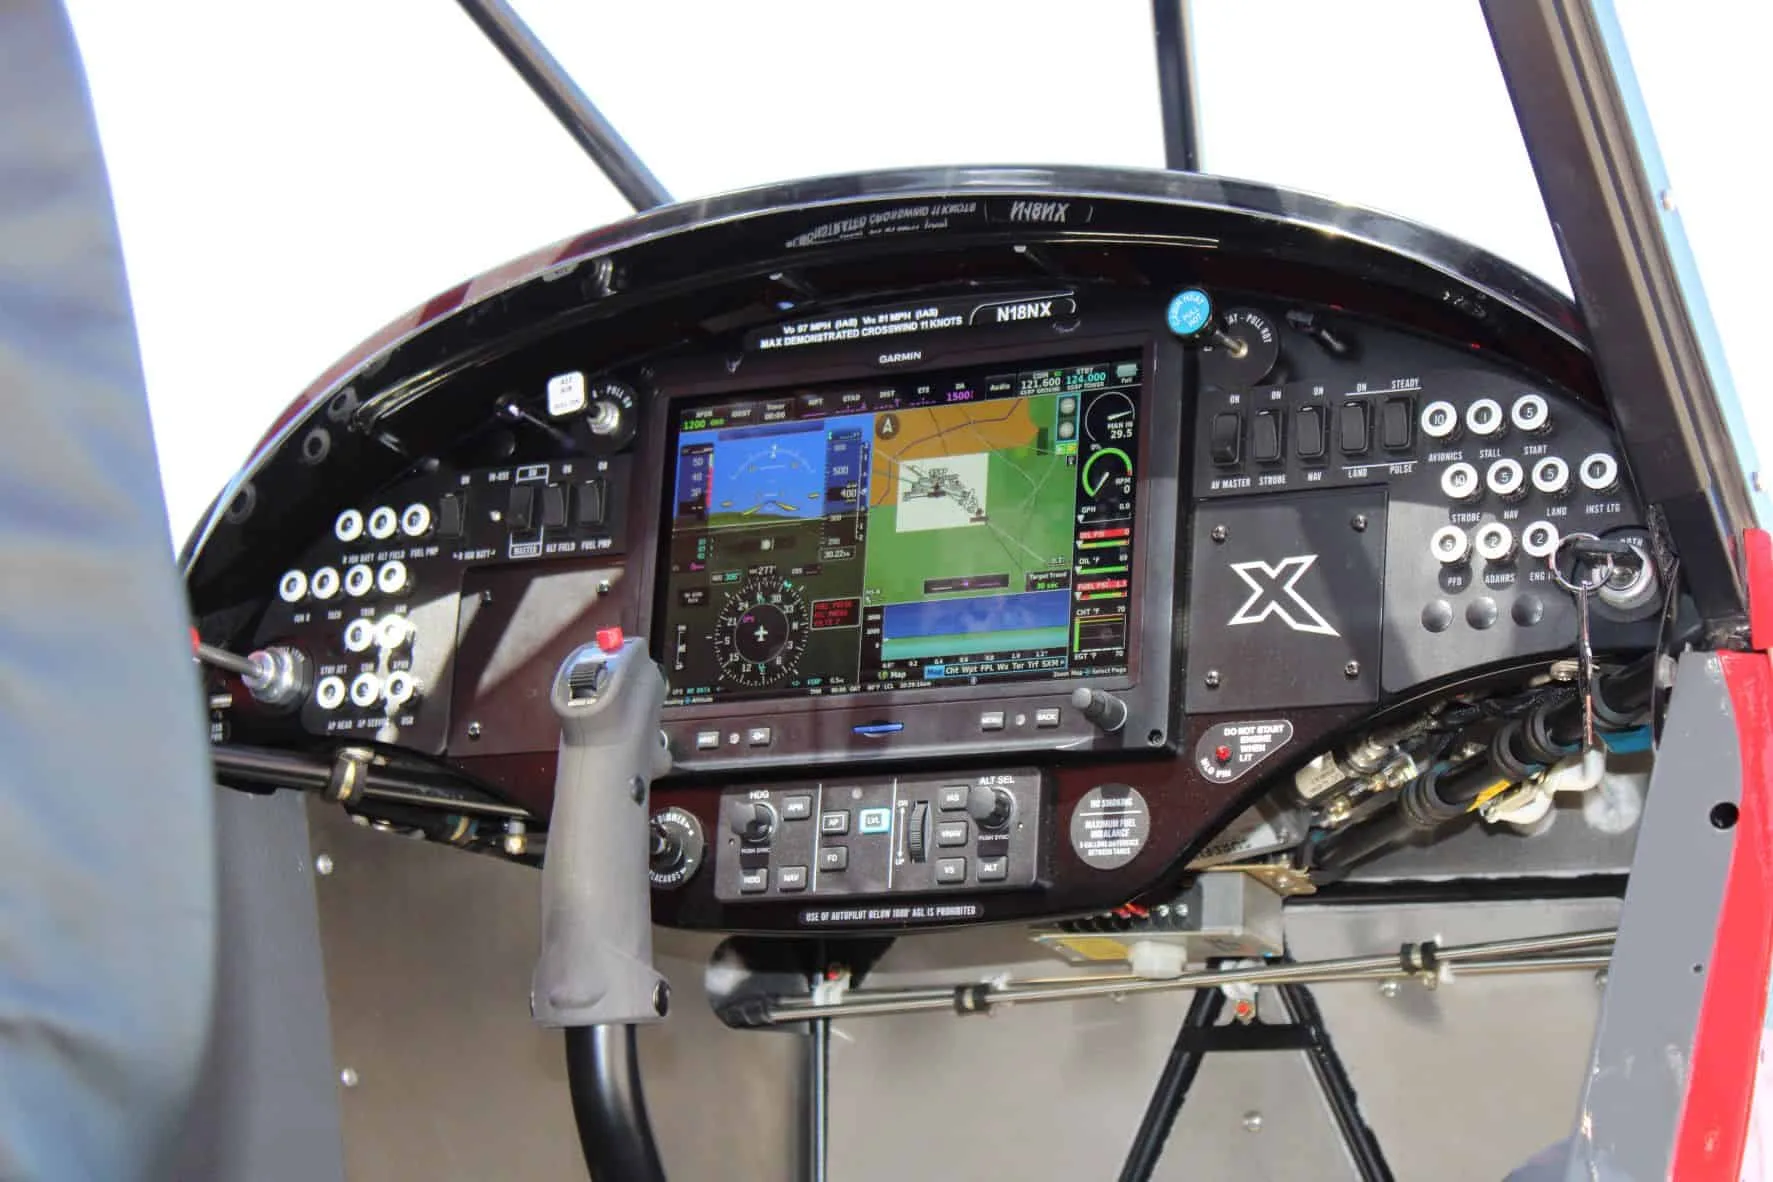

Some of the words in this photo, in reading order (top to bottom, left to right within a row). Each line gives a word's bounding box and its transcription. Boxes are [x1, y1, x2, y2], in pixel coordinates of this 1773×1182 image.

[997, 301, 1052, 322] N18NX
[760, 338, 782, 349] MAX
[784, 329, 860, 346] DEMONSTRATED
[861, 320, 918, 337] CROSSWIND
[929, 316, 963, 329] KNOTS
[880, 351, 921, 364] GARMIN
[1021, 377, 1061, 390] 121.600
[1066, 372, 1106, 384] 124.000
[1357, 383, 1367, 393] ON
[1391, 378, 1420, 390] STEADY
[1110, 429, 1133, 439] 29.5
[1479, 447, 1501, 458] STALL
[1523, 445, 1548, 456] START
[1428, 451, 1463, 462] AVIONICS
[1348, 468, 1368, 478] LAND
[1389, 463, 1413, 475] PULSE
[1258, 474, 1287, 486] STROBE
[1307, 472, 1322, 482] NAV
[1222, 478, 1251, 489] MASTER
[1547, 506, 1567, 517] LAND
[1586, 504, 1604, 514] INST
[1606, 503, 1620, 513] LTG
[1452, 512, 1481, 523] STROBE
[1504, 510, 1519, 520] NAV
[1485, 572, 1516, 583] ADAHRS
[1529, 572, 1545, 582] ENG
[1224, 727, 1237, 736] DO
[1238, 726, 1256, 735] NOT
[1257, 724, 1284, 734] START
[1239, 754, 1252, 762] LIT
[979, 776, 995, 785] ALT
[998, 776, 1015, 784] SEL
[750, 790, 769, 799] HDG
[984, 864, 997, 872] ALT
[806, 911, 819, 922] USE
[821, 911, 829, 921] OF
[831, 910, 867, 921] AUTOPILOT
[869, 909, 890, 919] BELOW
[912, 907, 925, 917] AGL
[927, 906, 934, 916] IS
[936, 905, 976, 916] PROHIBITED
